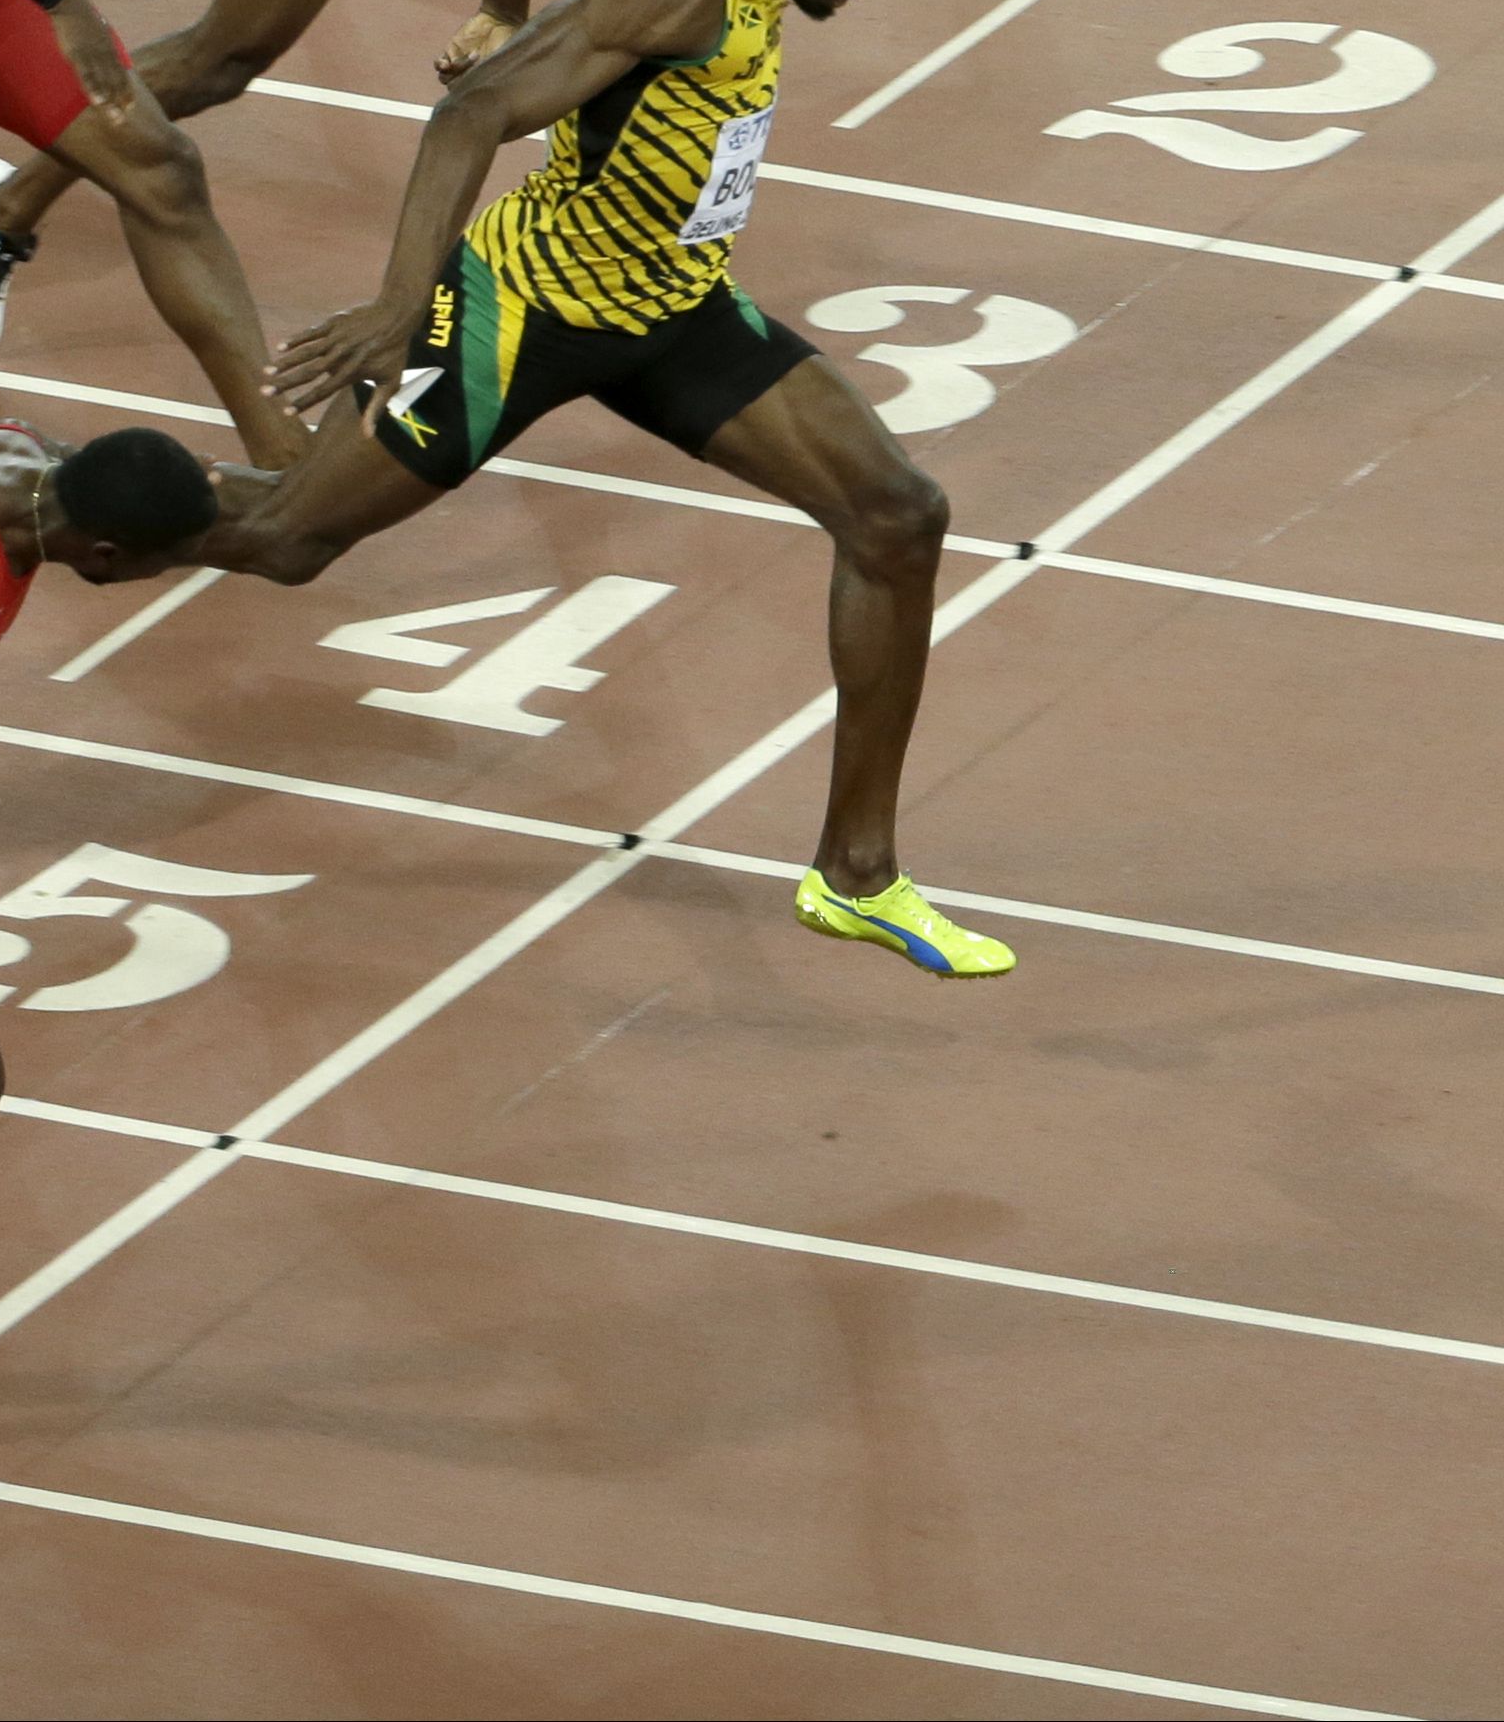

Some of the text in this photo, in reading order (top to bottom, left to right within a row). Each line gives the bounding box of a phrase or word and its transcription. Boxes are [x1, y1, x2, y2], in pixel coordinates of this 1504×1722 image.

[1042, 21, 1437, 171] 2
[427, 284, 454, 347] JAM
[804, 285, 1079, 434] 3
[316, 574, 678, 736] 4
